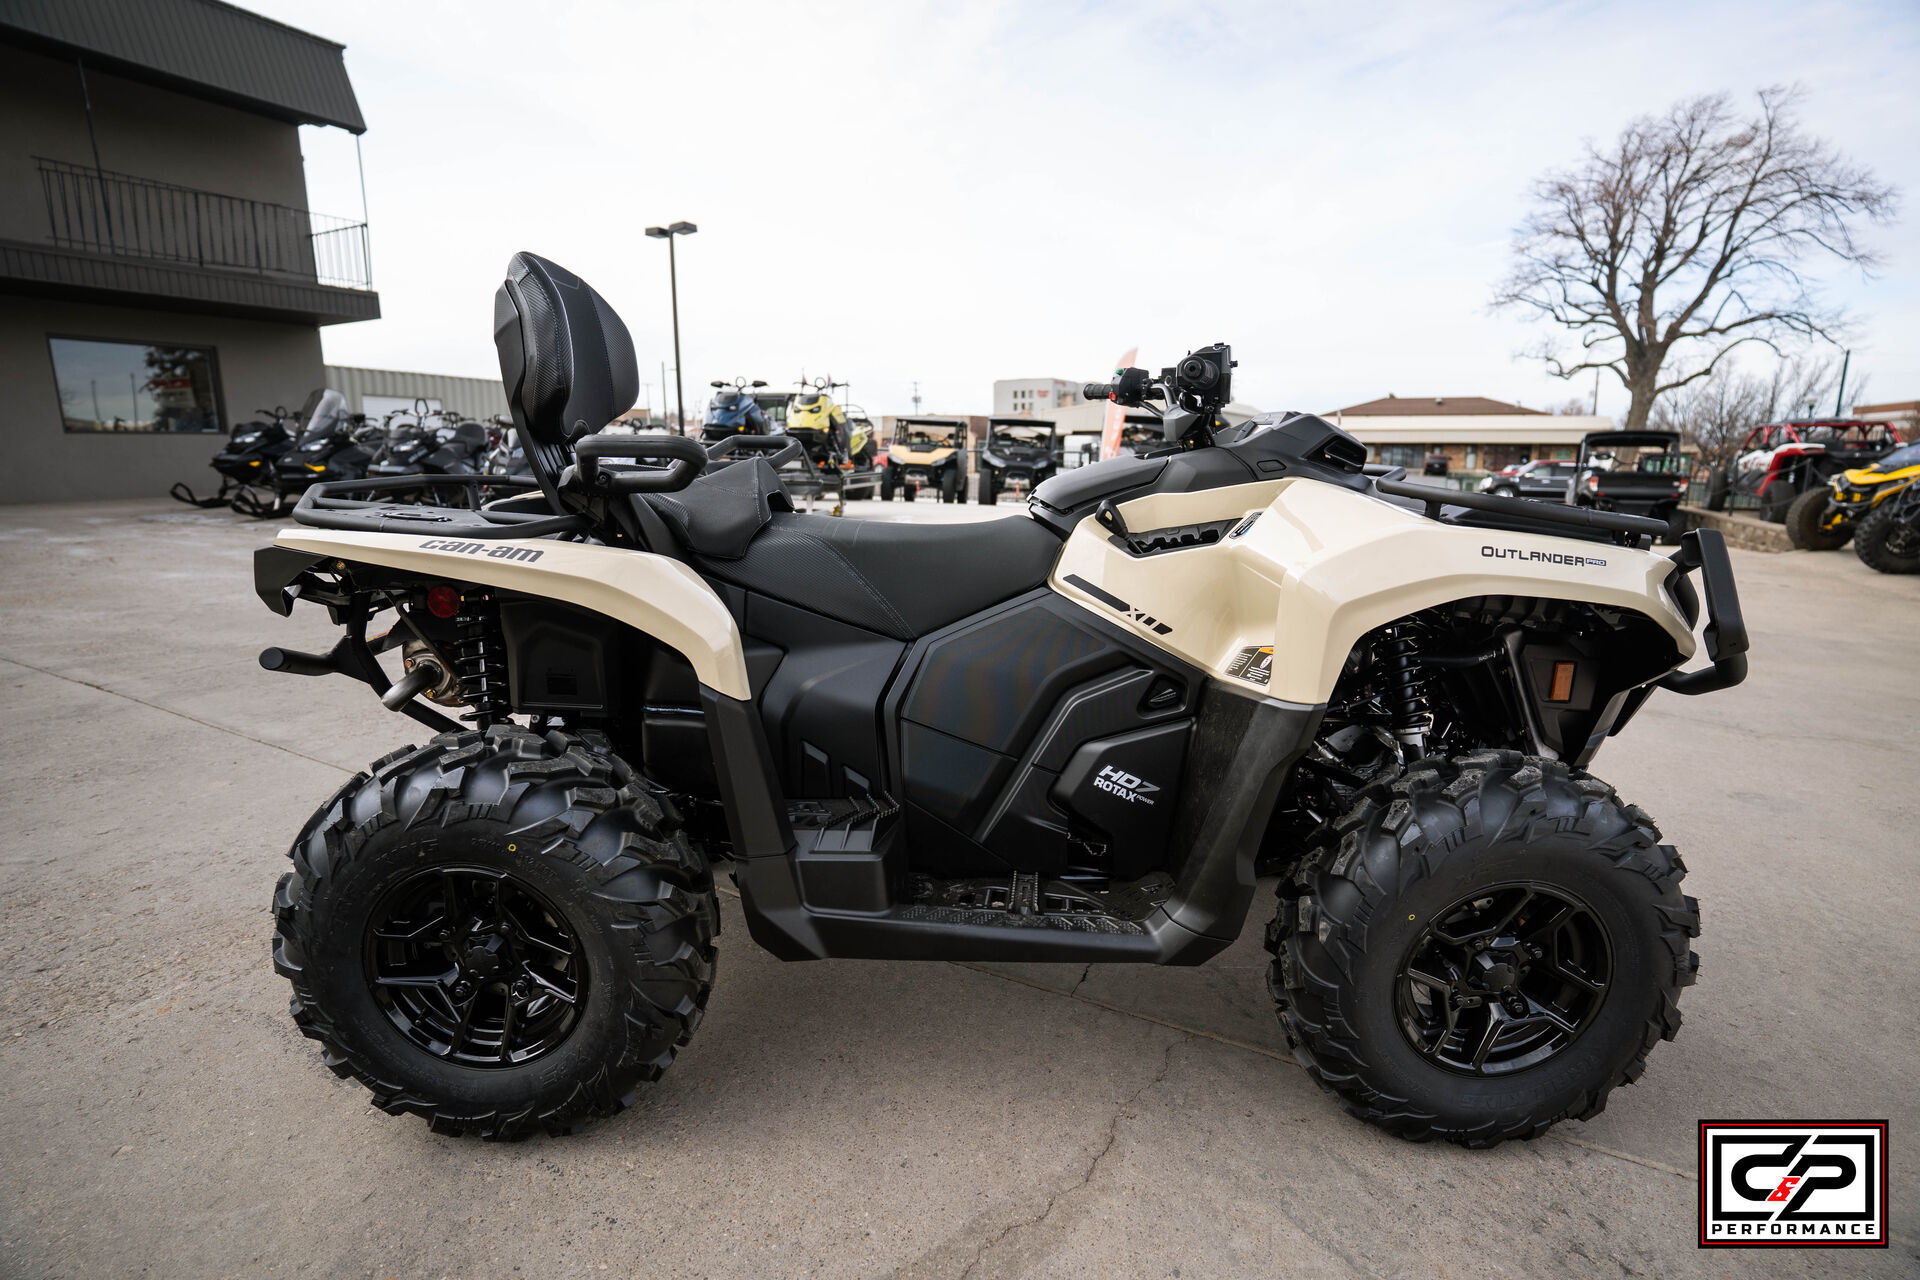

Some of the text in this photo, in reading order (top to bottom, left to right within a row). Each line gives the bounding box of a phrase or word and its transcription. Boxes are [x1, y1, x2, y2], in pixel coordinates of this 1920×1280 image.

[419, 540, 544, 563] can-am
[1481, 545, 1607, 567] OUTLANDER PRO
[1093, 776, 1155, 805] ROTAX POWER
[1098, 765, 1161, 793] HD7
